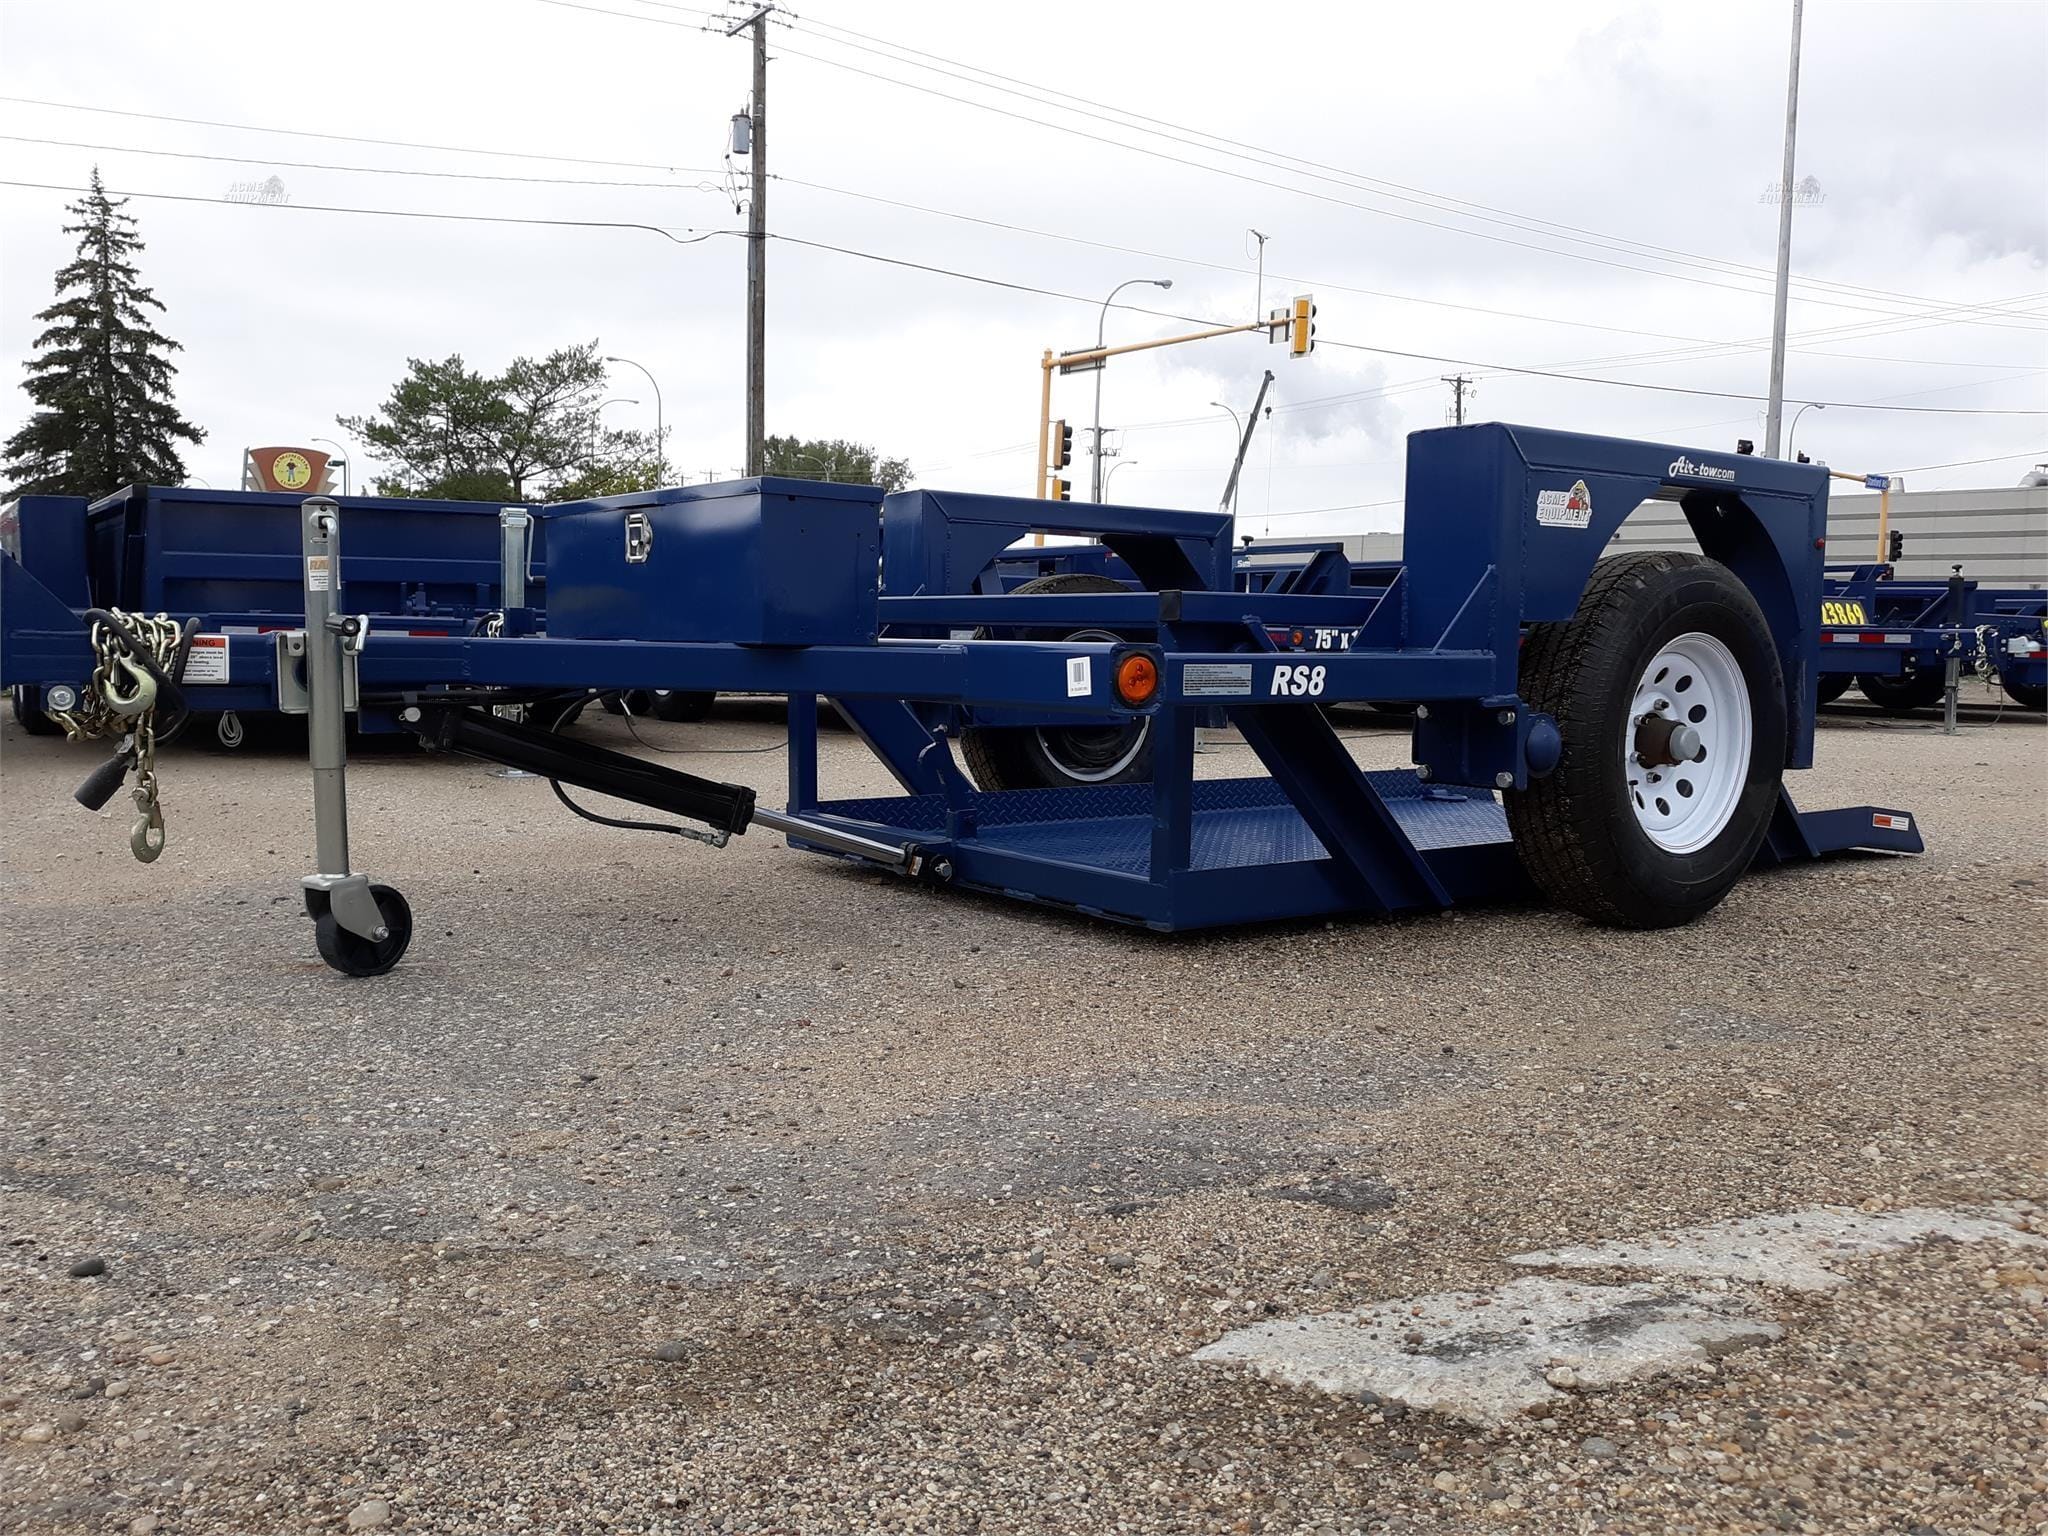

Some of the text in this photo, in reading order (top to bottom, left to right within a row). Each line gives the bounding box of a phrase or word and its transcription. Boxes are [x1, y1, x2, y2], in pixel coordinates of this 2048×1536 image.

[1668, 456, 1735, 480] Air-tow.com
[1538, 491, 1567, 506] ACME
[1537, 508, 1591, 522] EQUIPMENT
[1270, 665, 1326, 695] RS8
